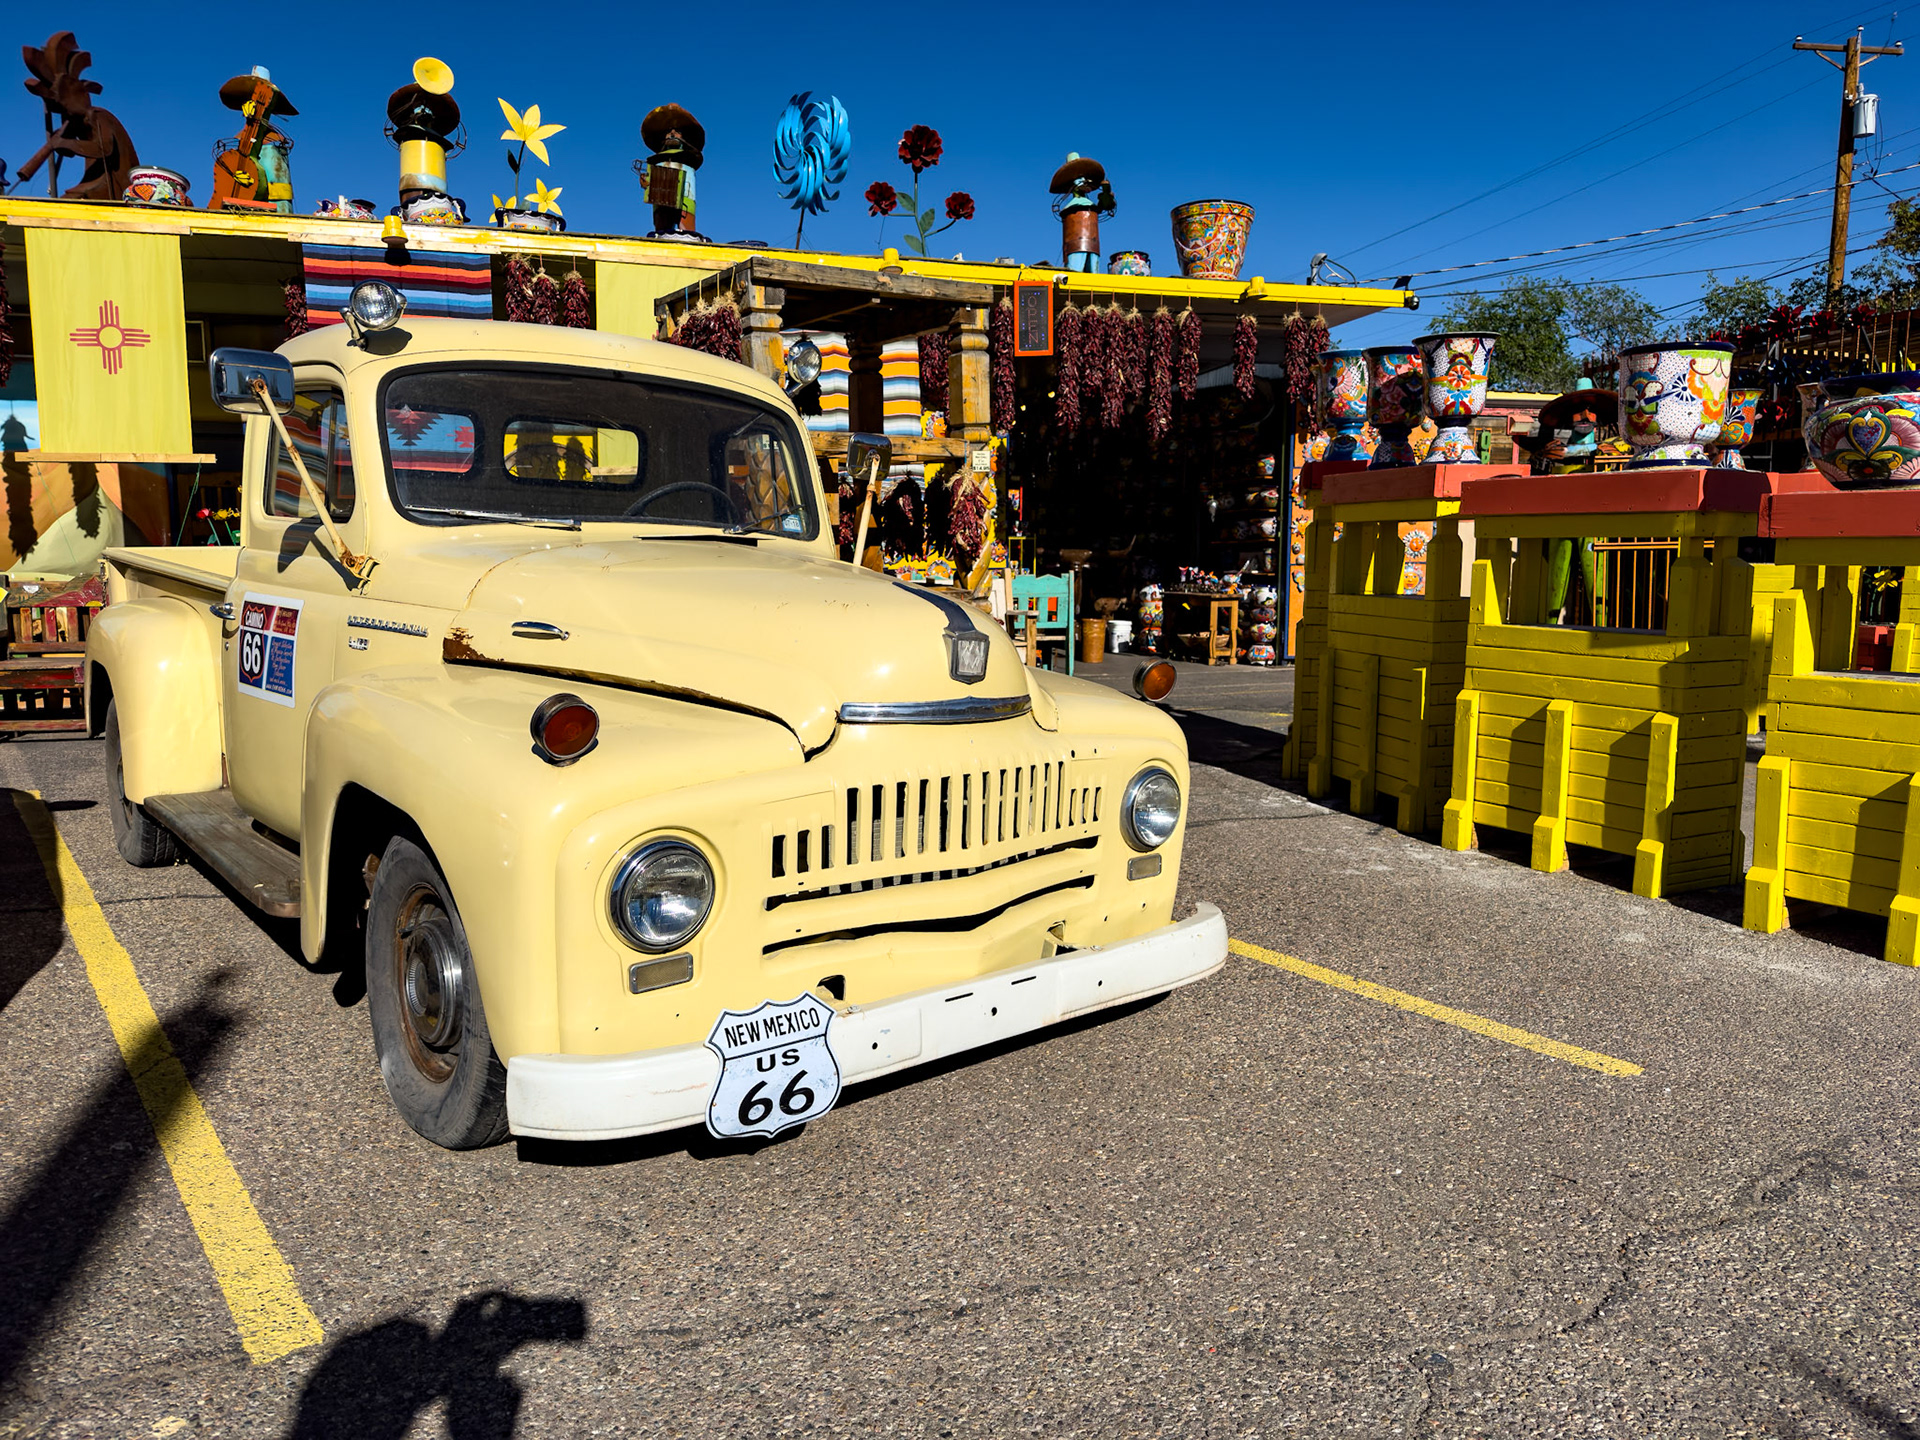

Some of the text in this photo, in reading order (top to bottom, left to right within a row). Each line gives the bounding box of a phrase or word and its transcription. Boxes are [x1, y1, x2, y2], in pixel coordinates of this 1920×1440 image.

[1027, 295, 1039, 345] OPEN
[245, 610, 264, 629] CAMINO
[242, 632, 261, 674] 66
[724, 1007, 820, 1049] NEW MEXICO
[756, 1048, 801, 1073] US
[738, 1069, 815, 1126] 66
